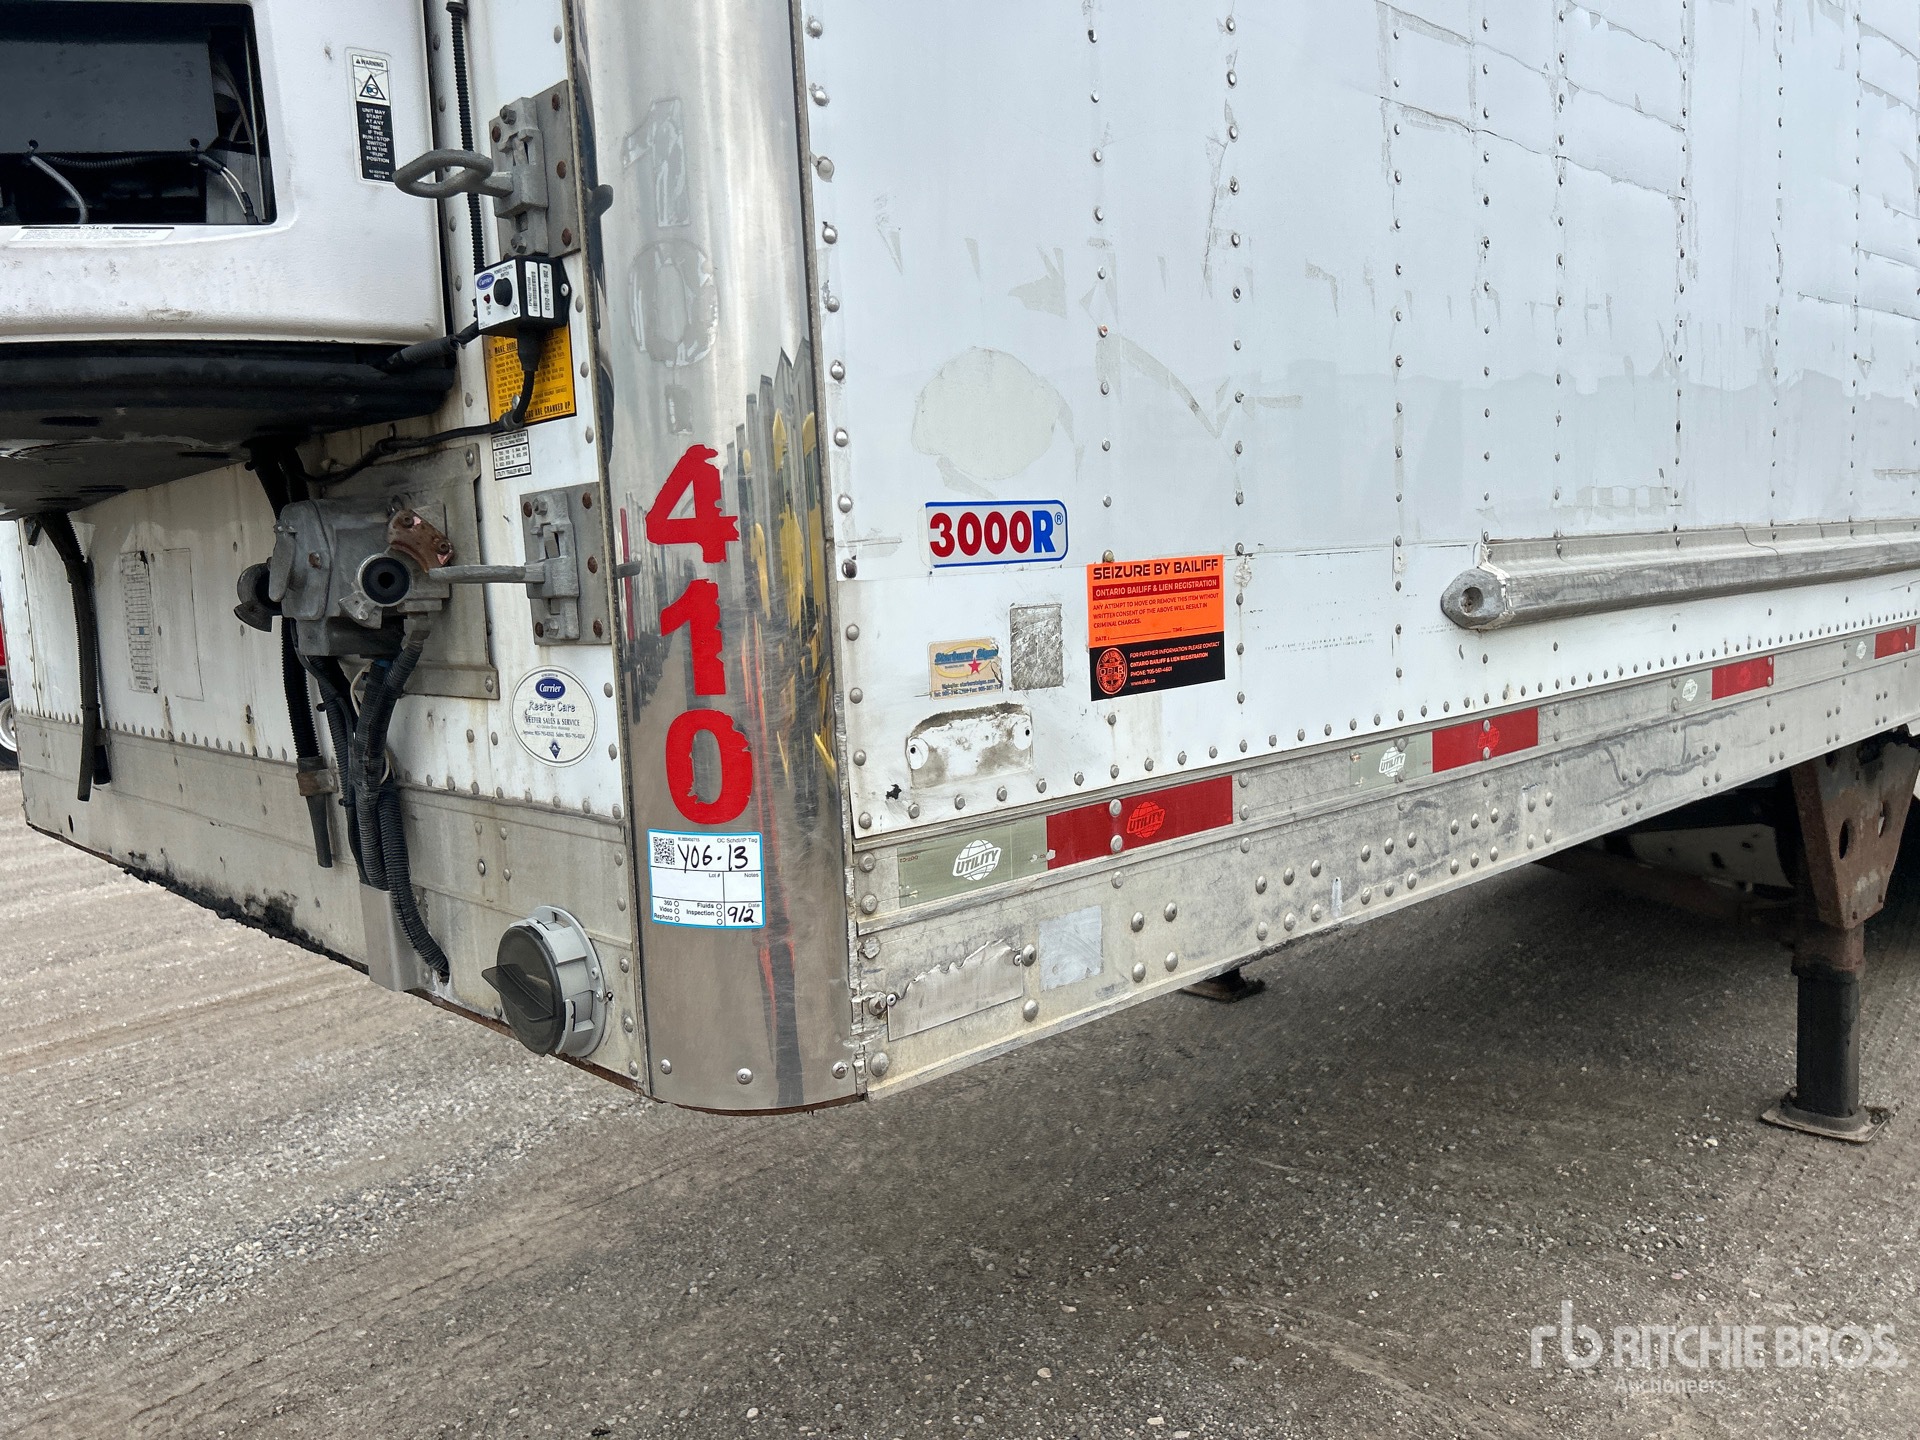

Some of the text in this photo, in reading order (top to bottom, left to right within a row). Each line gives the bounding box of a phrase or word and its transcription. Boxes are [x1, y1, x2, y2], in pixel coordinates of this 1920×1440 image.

[361, 58, 384, 68] WARNING
[1093, 558, 1219, 580] SEIZURE BY BAILIFF
[1096, 579, 1217, 597] ONTARIO BAILIFF & LIEN REGISTRATION
[1104, 601, 1126, 610] ATTEMPT
[1157, 596, 1176, 605] REMOVE
[1199, 593, 1219, 601] WITHOUT
[1093, 611, 1115, 620] WRITTEN
[1116, 609, 1138, 618] CONSENT
[1093, 618, 1142, 629] CRIMINAL CHARGES.
[1159, 646, 1188, 655] INFORMATION
[1203, 641, 1220, 649] CONTACT
[1130, 660, 1149, 668] ONTARIO
[1180, 652, 1209, 661] REGISTRATION
[540, 683, 562, 693] Carrier
[528, 700, 576, 712] Reefer Care
[561, 718, 580, 726] SERVICE
[1381, 754, 1405, 771] UTILITY
[1129, 810, 1164, 832] UTILITY
[956, 850, 999, 874] UTILITY
